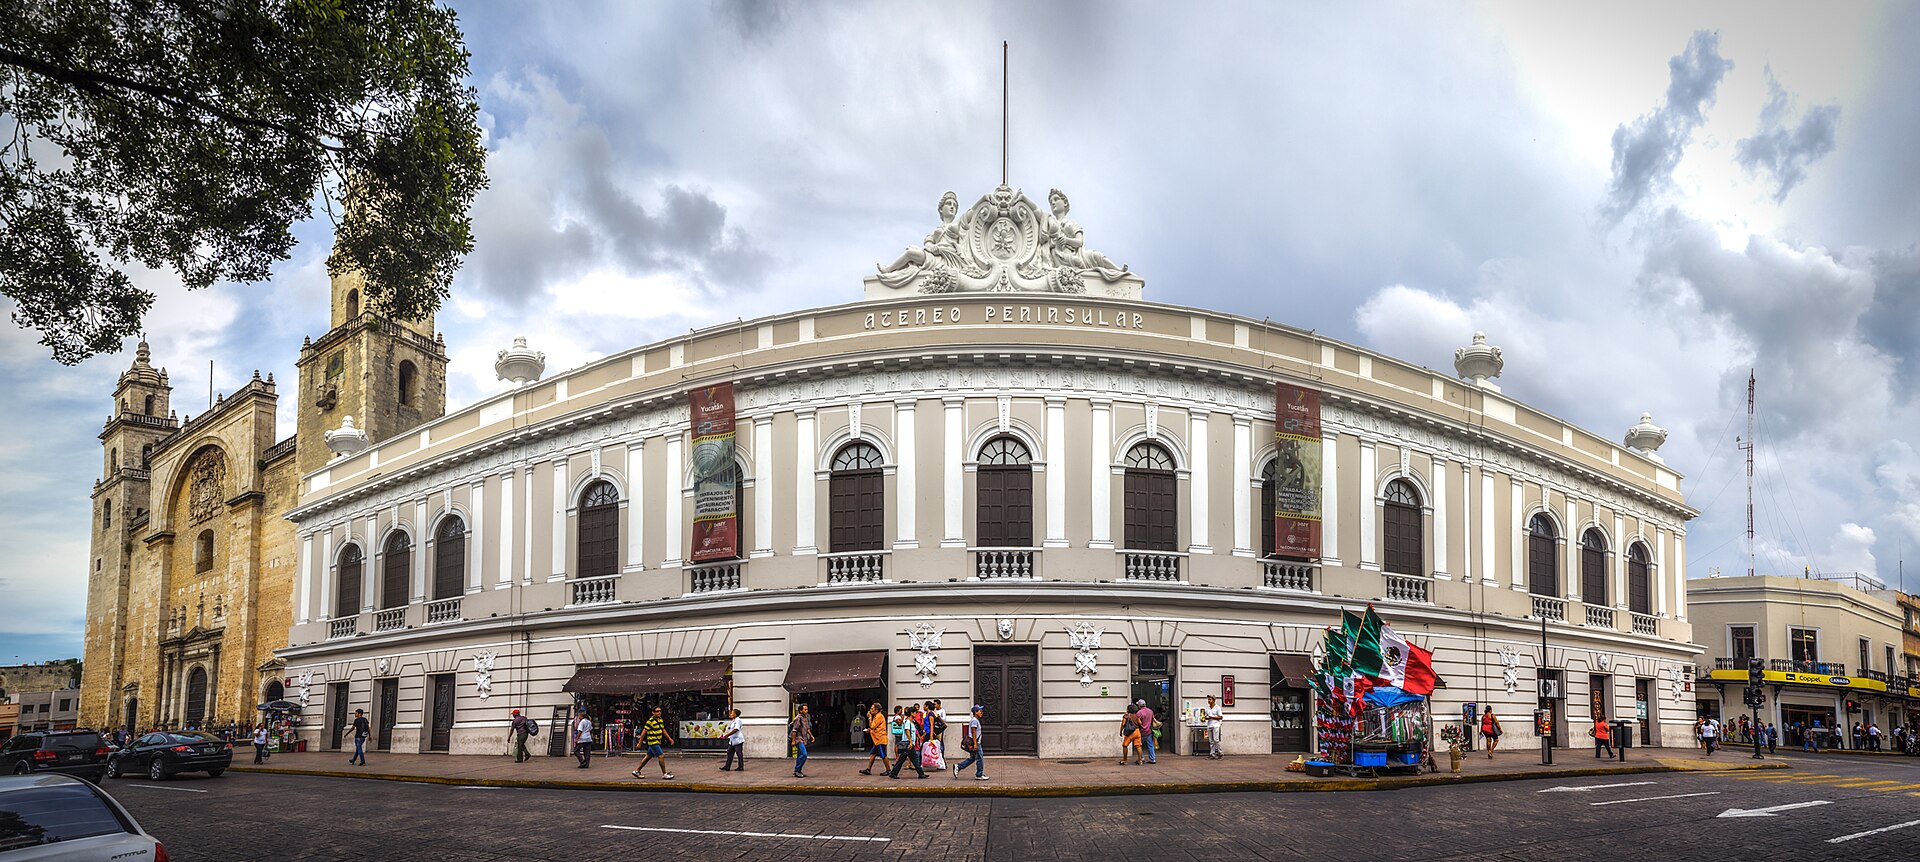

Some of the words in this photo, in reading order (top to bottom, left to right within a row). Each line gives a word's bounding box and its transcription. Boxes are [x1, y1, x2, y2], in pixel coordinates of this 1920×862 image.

[864, 307, 962, 329] ATENEO
[984, 306, 1144, 329] PENINSULAR
[701, 403, 723, 412] Yucatán
[1287, 403, 1308, 412] Yucatán
[111, 850, 147, 860] ATTITUD
